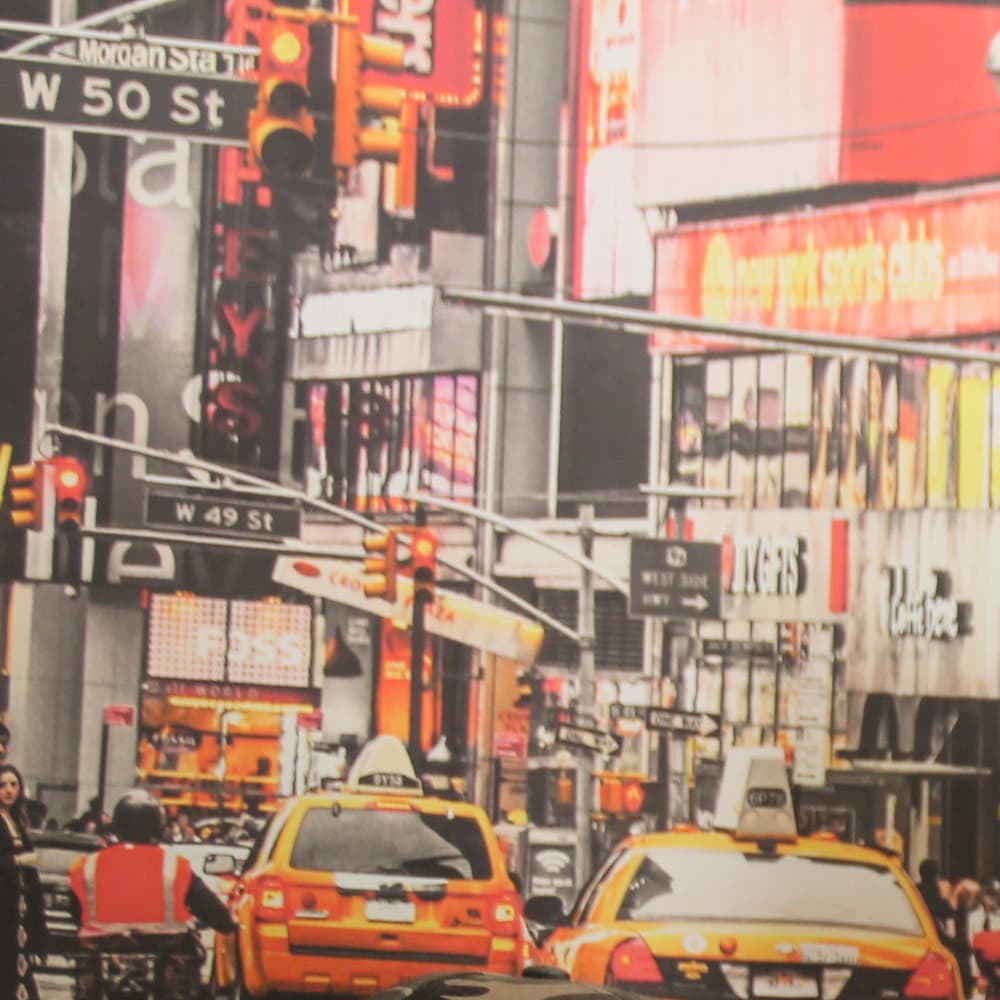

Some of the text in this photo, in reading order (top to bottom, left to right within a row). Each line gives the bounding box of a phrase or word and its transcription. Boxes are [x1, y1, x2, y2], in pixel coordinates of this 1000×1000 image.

[20, 70, 225, 129] W 50 St
[176, 503, 273, 532] W 49 St
[641, 570, 675, 586] WEST
